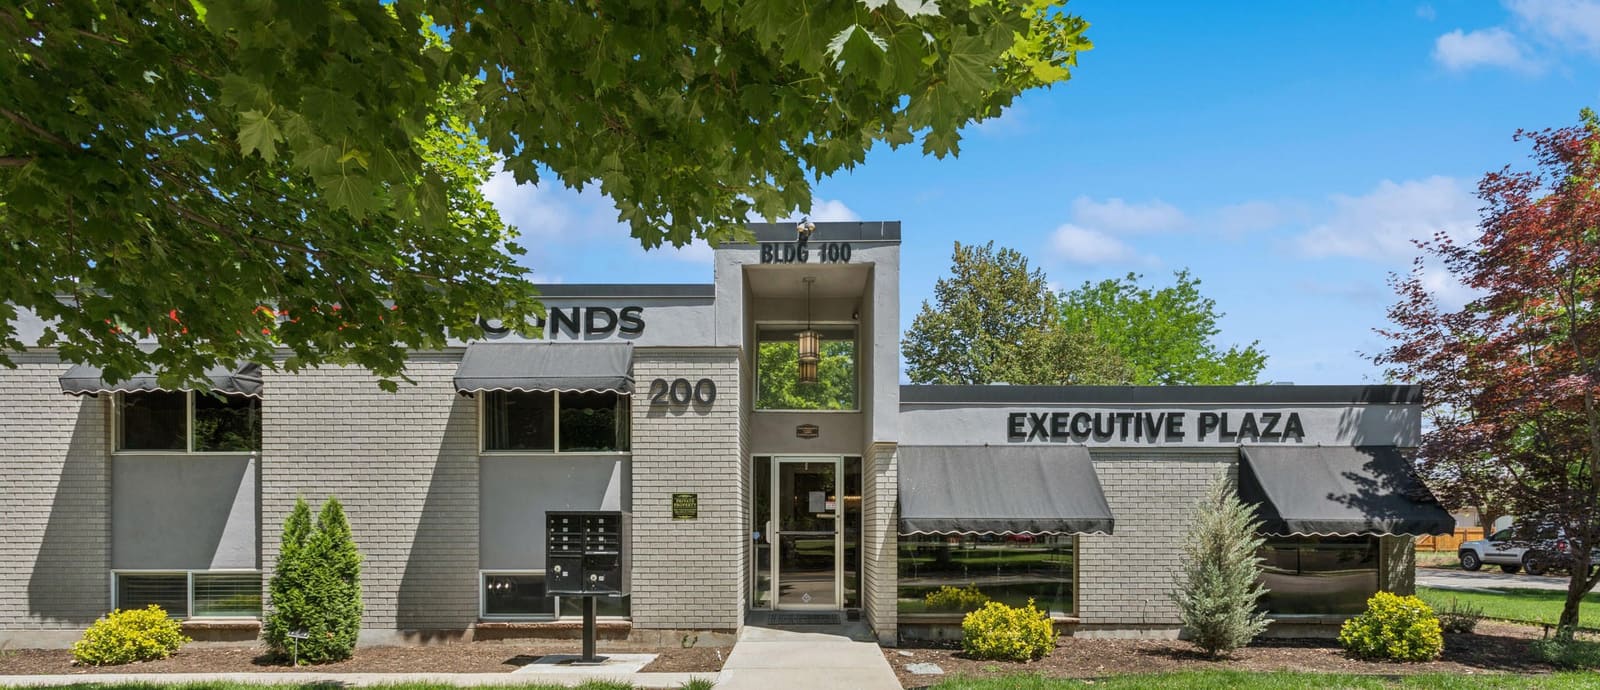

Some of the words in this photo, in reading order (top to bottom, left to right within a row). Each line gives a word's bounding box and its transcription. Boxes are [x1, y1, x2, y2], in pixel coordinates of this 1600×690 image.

[761, 243, 809, 263] BLDG
[818, 243, 852, 263] 100
[649, 378, 717, 405] 200
[1008, 412, 1185, 438] EXECUTIVE
[1200, 412, 1306, 438] PLAZA
